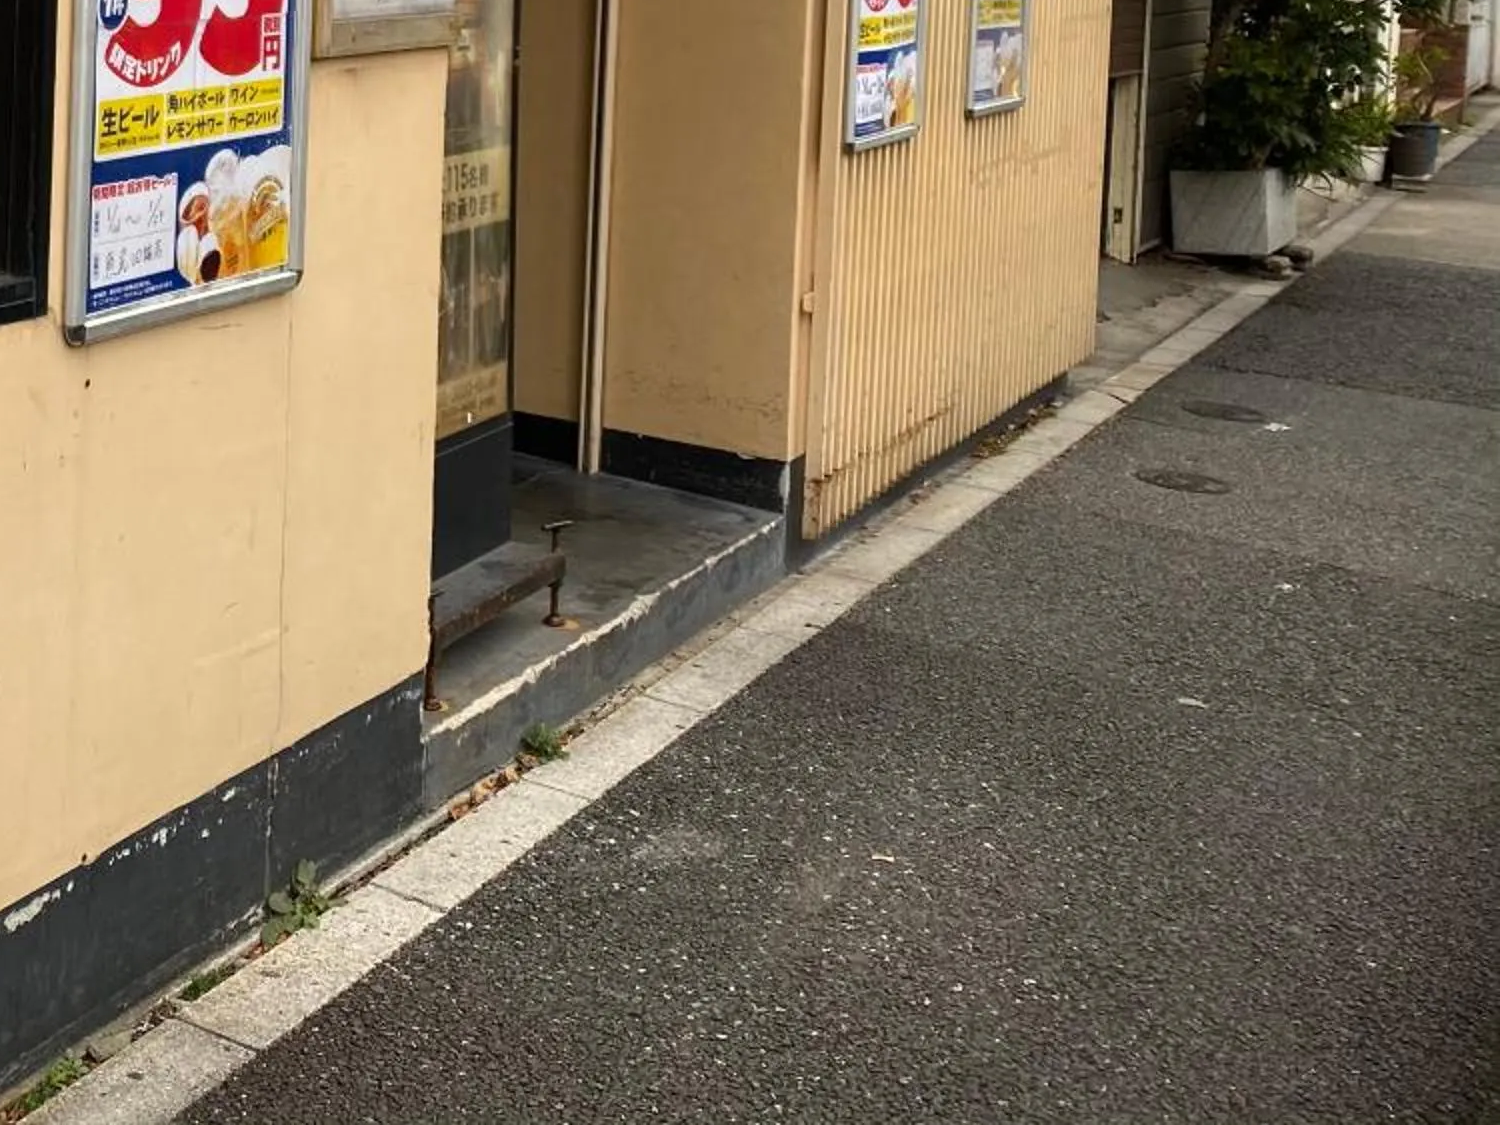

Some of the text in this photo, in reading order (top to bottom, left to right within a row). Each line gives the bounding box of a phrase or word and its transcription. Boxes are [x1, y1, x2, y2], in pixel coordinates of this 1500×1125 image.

[101, 104, 161, 137] 生ビール
[167, 117, 223, 139] レモンサワー
